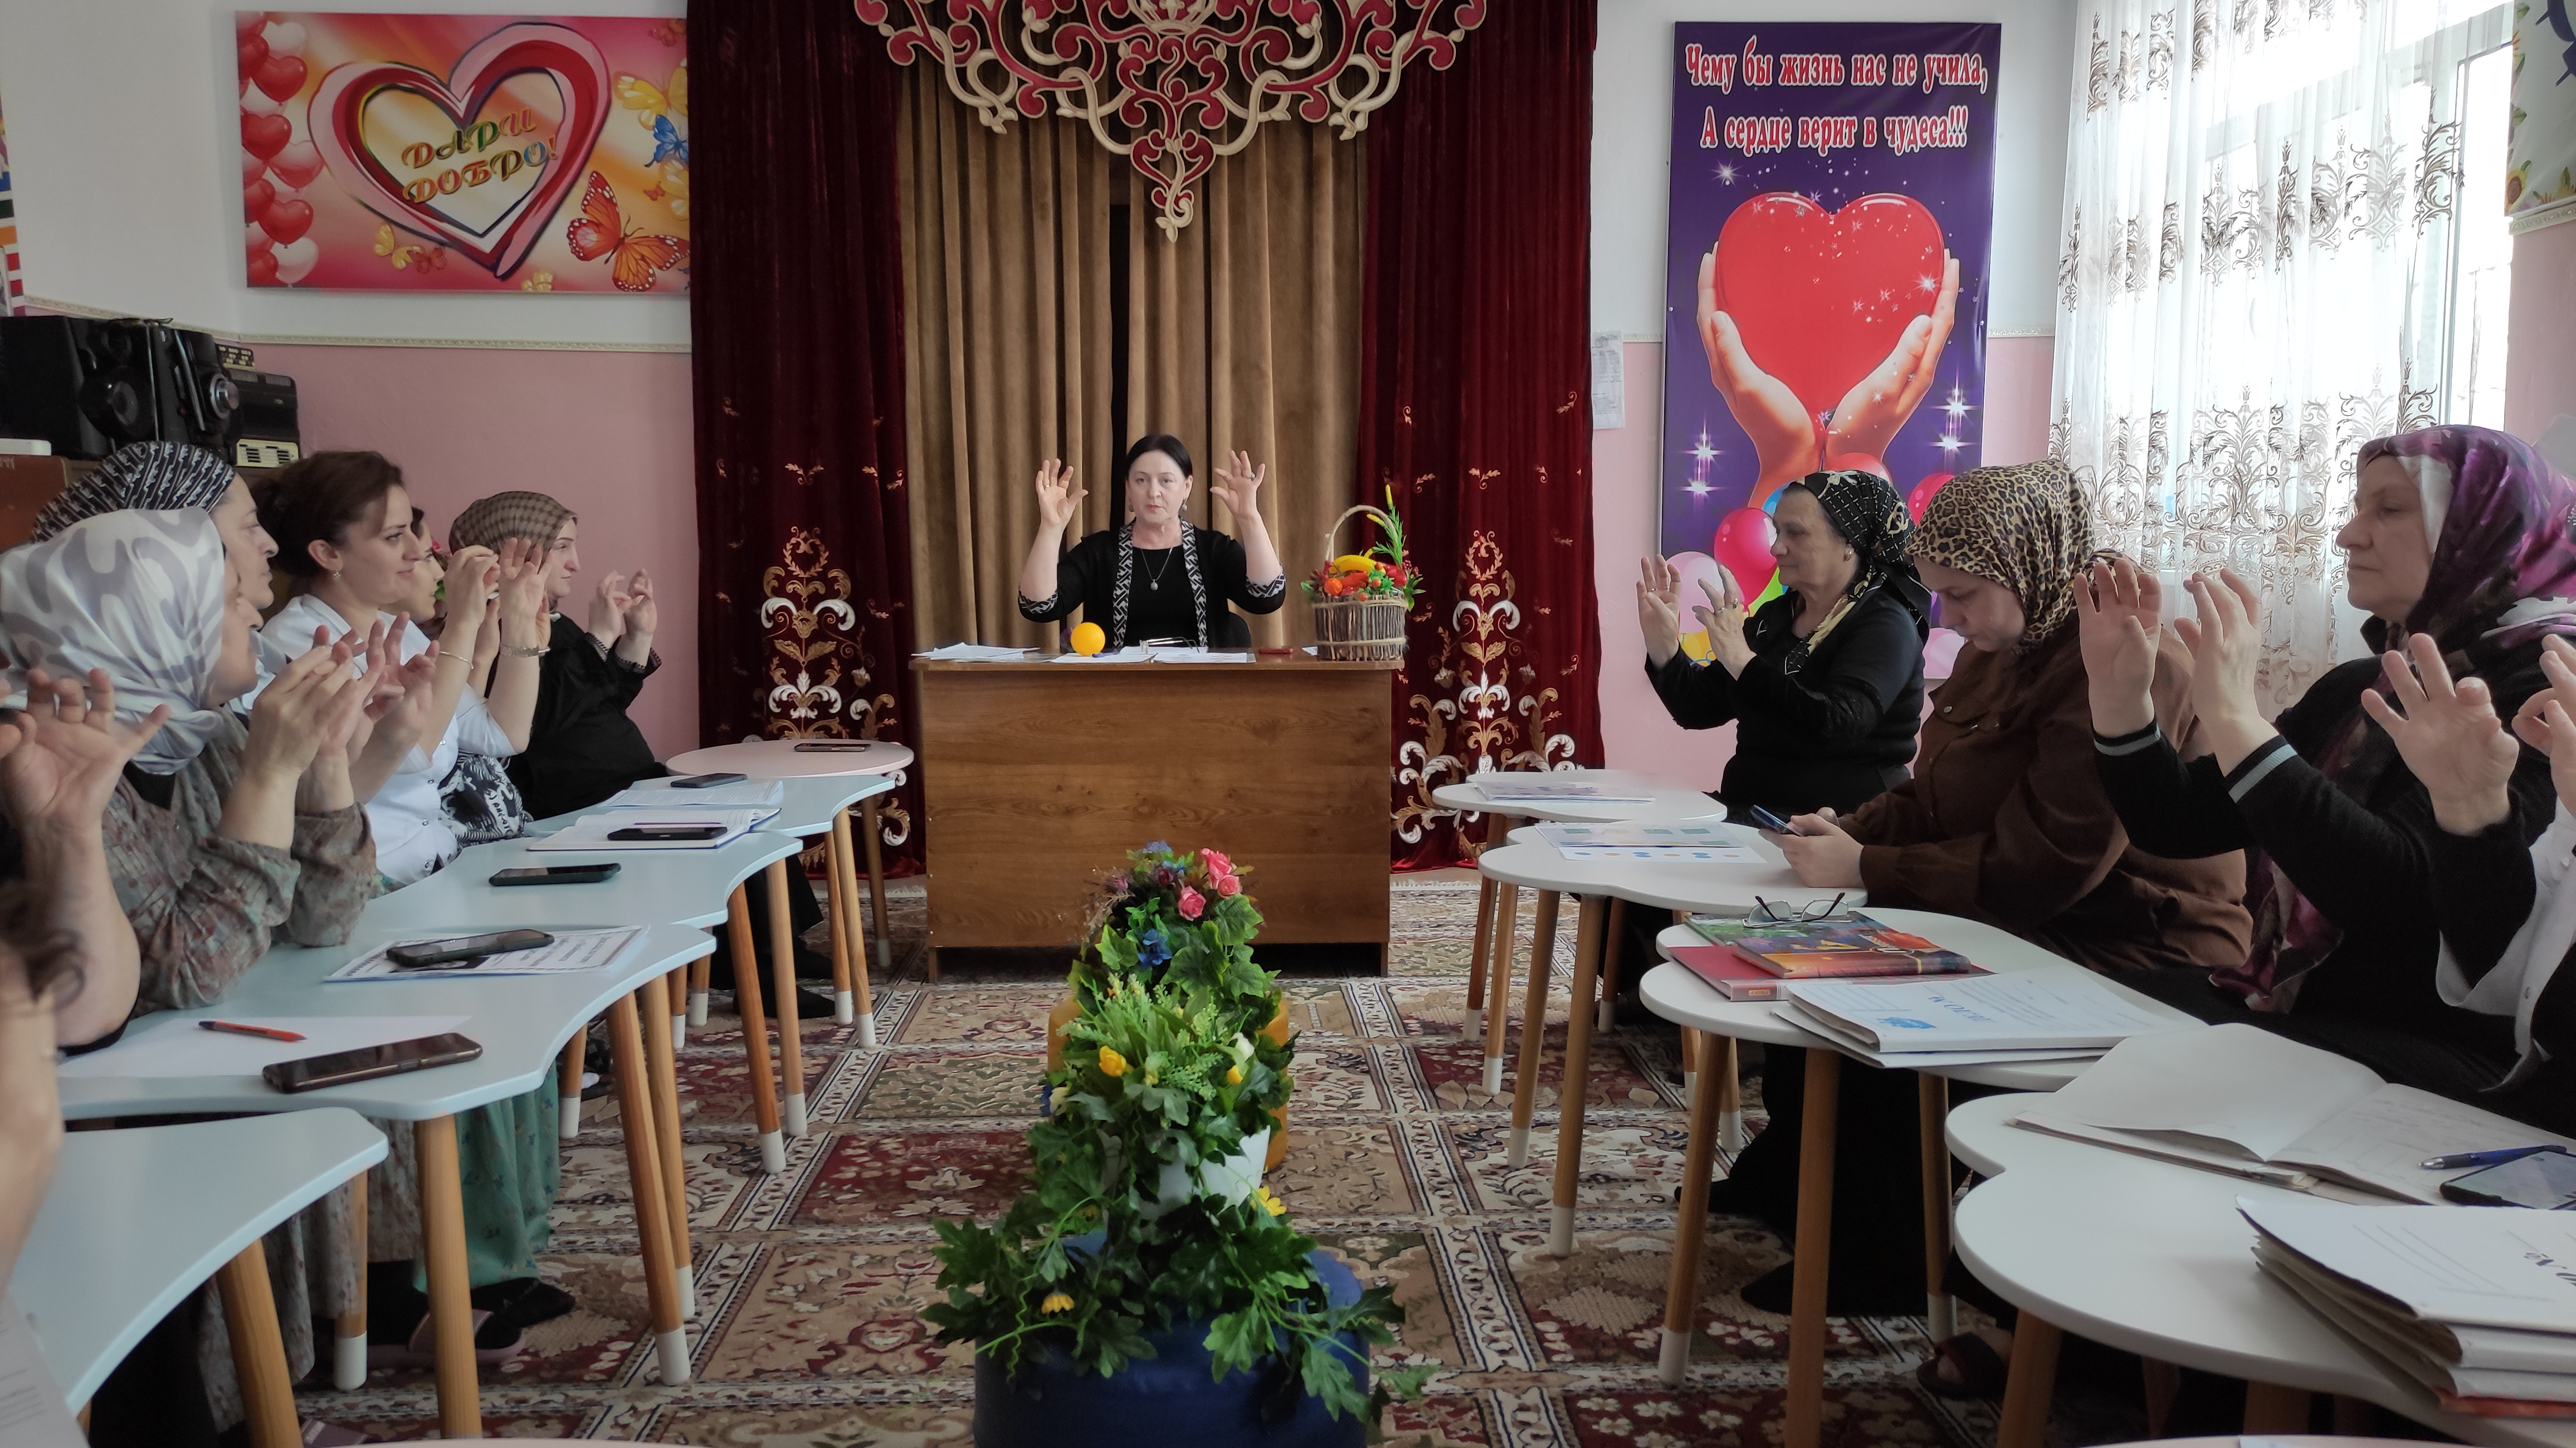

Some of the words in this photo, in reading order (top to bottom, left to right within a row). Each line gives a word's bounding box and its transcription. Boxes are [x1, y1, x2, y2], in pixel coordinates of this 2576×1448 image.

[1685, 43, 1736, 94] Чему
[1743, 35, 1773, 86] бы
[1778, 53, 1845, 86] жизнь
[1851, 53, 1886, 86] нас
[1892, 53, 1917, 86] не
[1923, 53, 1988, 94] учила,
[1700, 105, 1718, 148] А
[1724, 116, 1791, 156] сердце
[1798, 116, 1858, 156] верит
[1862, 116, 1877, 148] в
[1884, 105, 1968, 156] чудеса!!!
